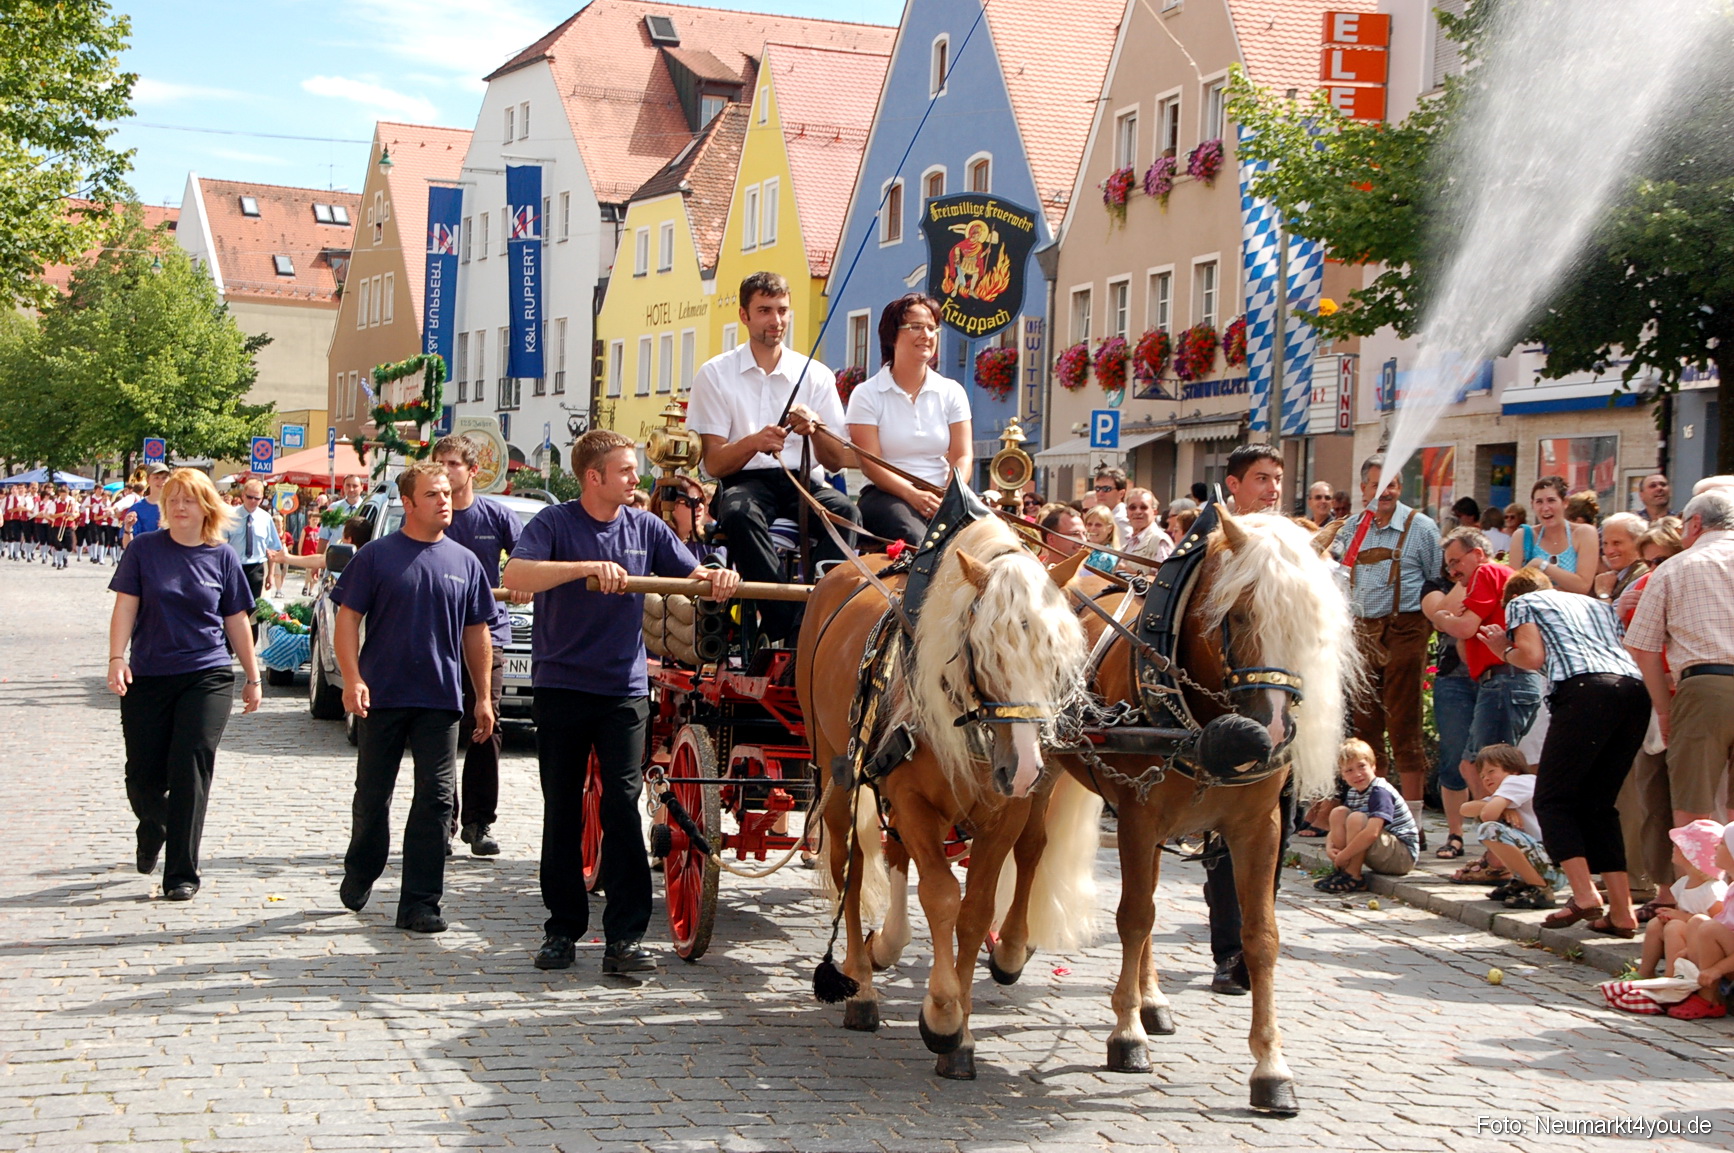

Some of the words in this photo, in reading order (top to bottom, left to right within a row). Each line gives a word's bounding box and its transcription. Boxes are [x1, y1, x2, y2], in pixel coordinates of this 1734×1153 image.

[930, 201, 985, 222] Freiwillige
[984, 200, 1034, 233] Feuerwehr
[523, 245, 535, 320] RUPPERT
[646, 302, 672, 327] HOTEL
[678, 299, 709, 320] Lehmeier
[940, 297, 1011, 336] Kruppach
[525, 322, 537, 353] K&L
[1025, 337, 1041, 415] WITTL
[1340, 358, 1352, 429] KINO
[1096, 414, 1114, 444] P
[252, 461, 271, 471] TAXI
[509, 659, 528, 673] NN
